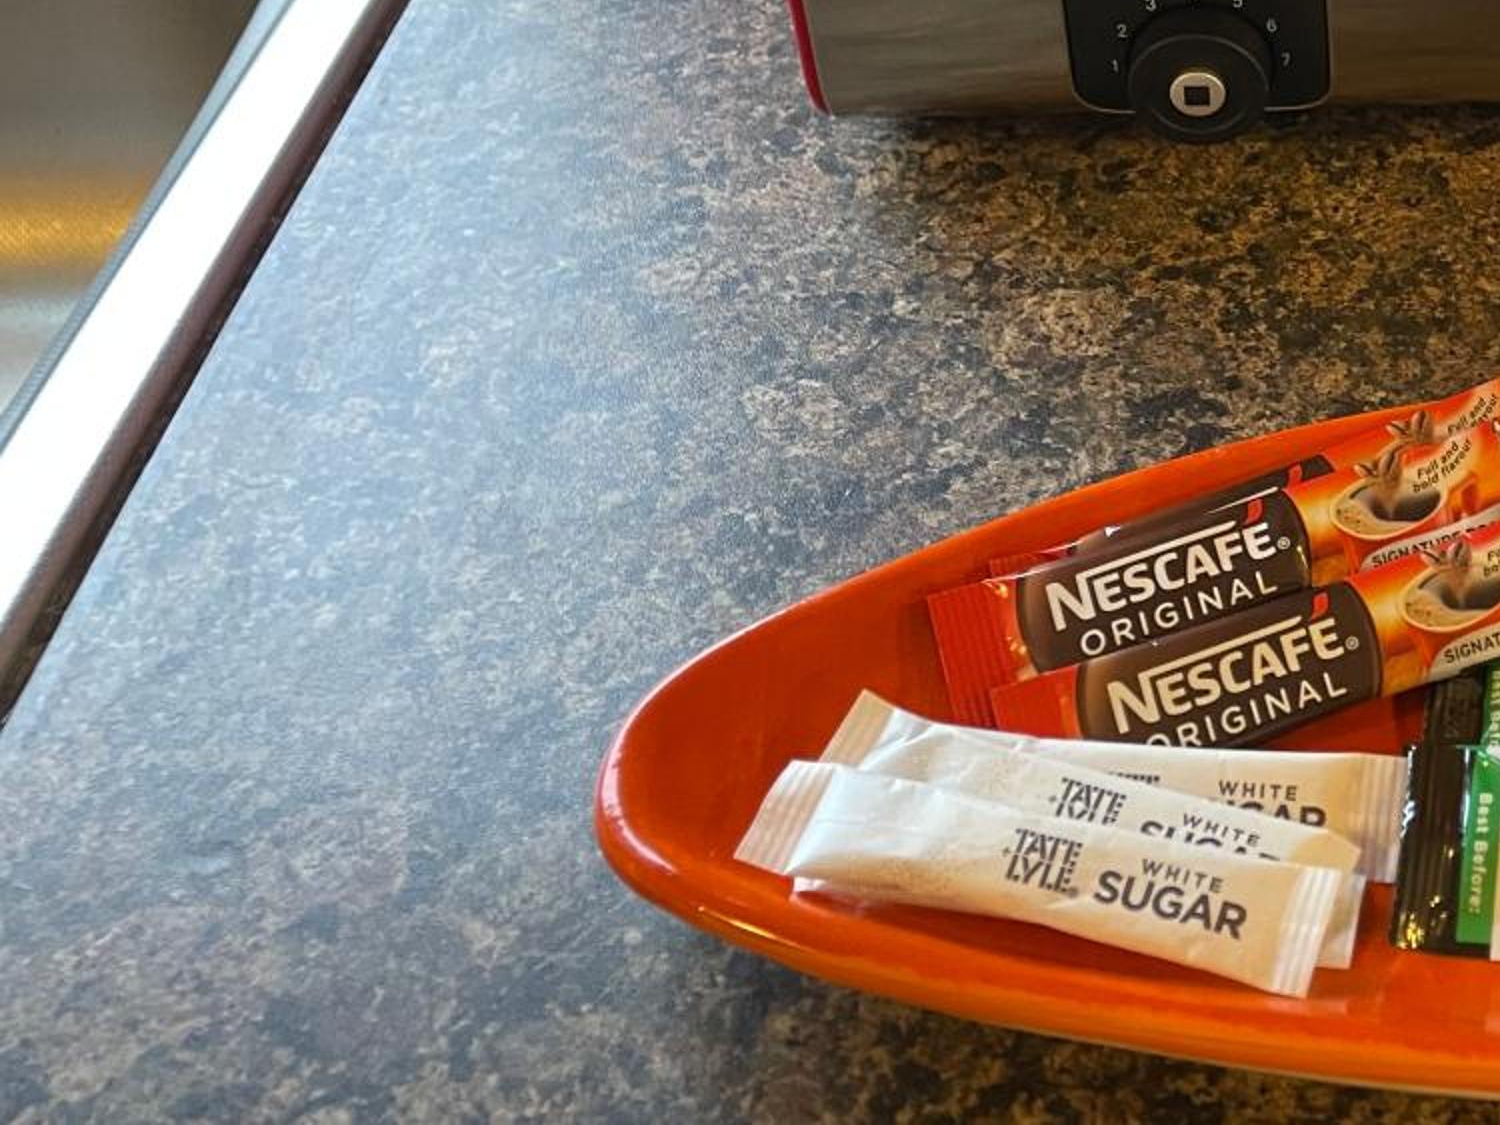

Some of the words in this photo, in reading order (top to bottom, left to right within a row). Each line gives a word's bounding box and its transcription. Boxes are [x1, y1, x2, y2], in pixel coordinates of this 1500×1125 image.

[1111, 59, 1119, 73] 1
[1117, 24, 1128, 38] 2
[1266, 17, 1278, 33] 6
[1281, 53, 1292, 66] 7
[1413, 472, 1439, 493] bold
[1440, 438, 1473, 475] flavour
[1417, 458, 1439, 479] Full
[1440, 441, 1459, 465] and
[1080, 570, 1278, 656] ORIGINAL
[1062, 777, 1127, 814] TATE
[1218, 778, 1298, 802] WHITE
[1183, 812, 1261, 848] WHITE
[1476, 792, 1494, 833] Best
[1015, 827, 1084, 866] TATE
[1006, 854, 1077, 893] LYLE
[1142, 857, 1225, 893] WHITE
[1468, 840, 1489, 915] Before:
[1093, 869, 1248, 941] SUGAR
